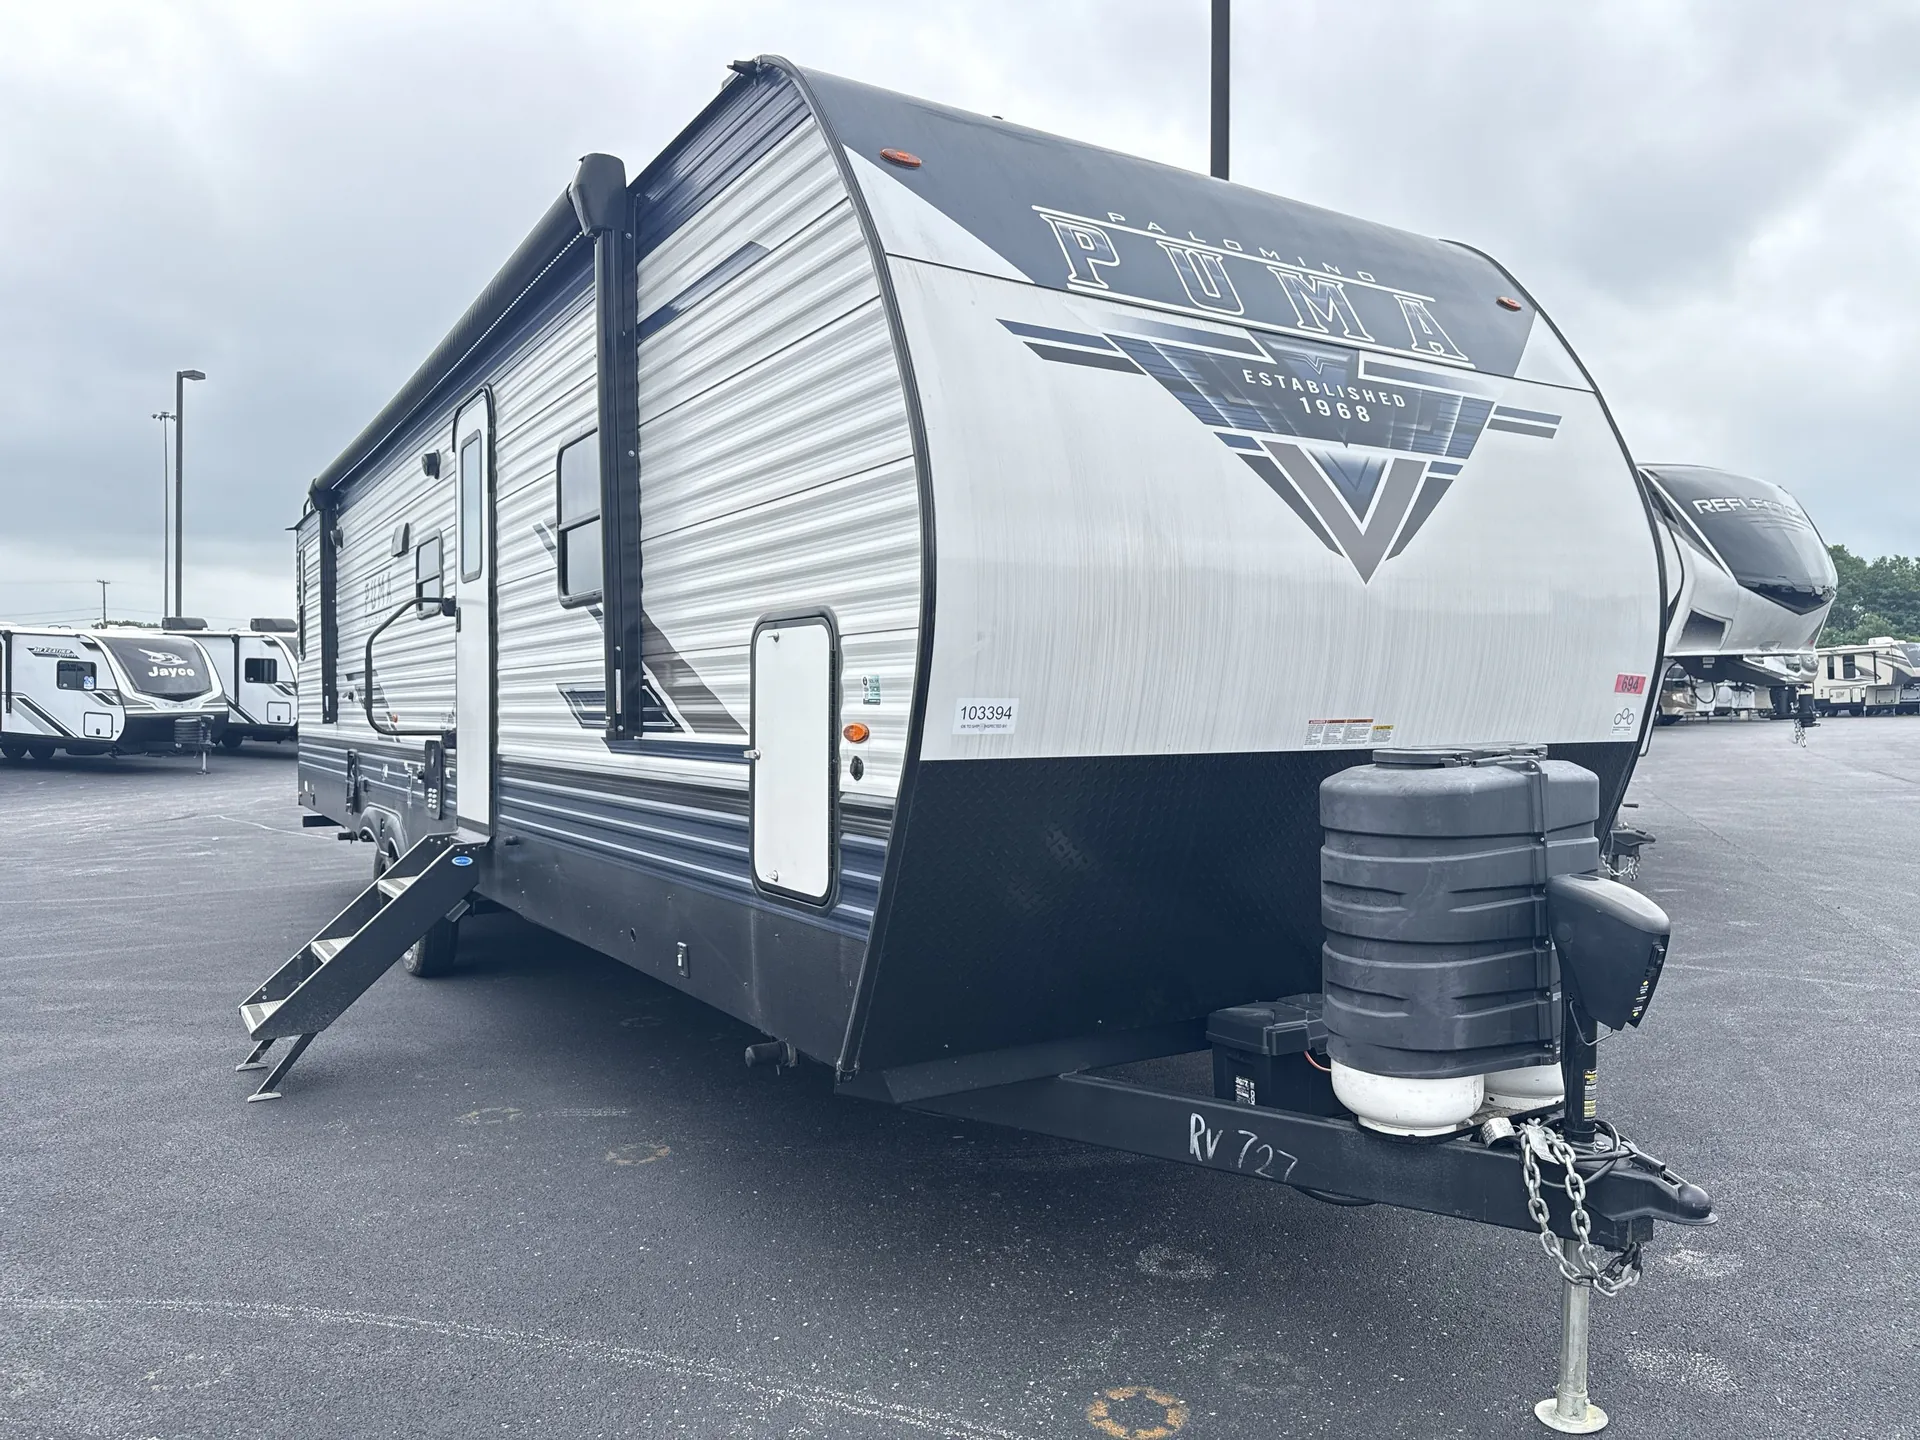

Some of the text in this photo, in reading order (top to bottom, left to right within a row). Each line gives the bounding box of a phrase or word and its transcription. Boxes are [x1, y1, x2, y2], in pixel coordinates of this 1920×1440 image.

[1107, 211, 1376, 283] PALOMINO
[1039, 213, 1469, 361] PUMA
[1242, 369, 1406, 407] ESTABLISHED
[1300, 396, 1371, 422] 1968
[148, 666, 195, 678] Jayco
[960, 705, 1012, 720] 103394
[1238, 1130, 1298, 1182] 727
